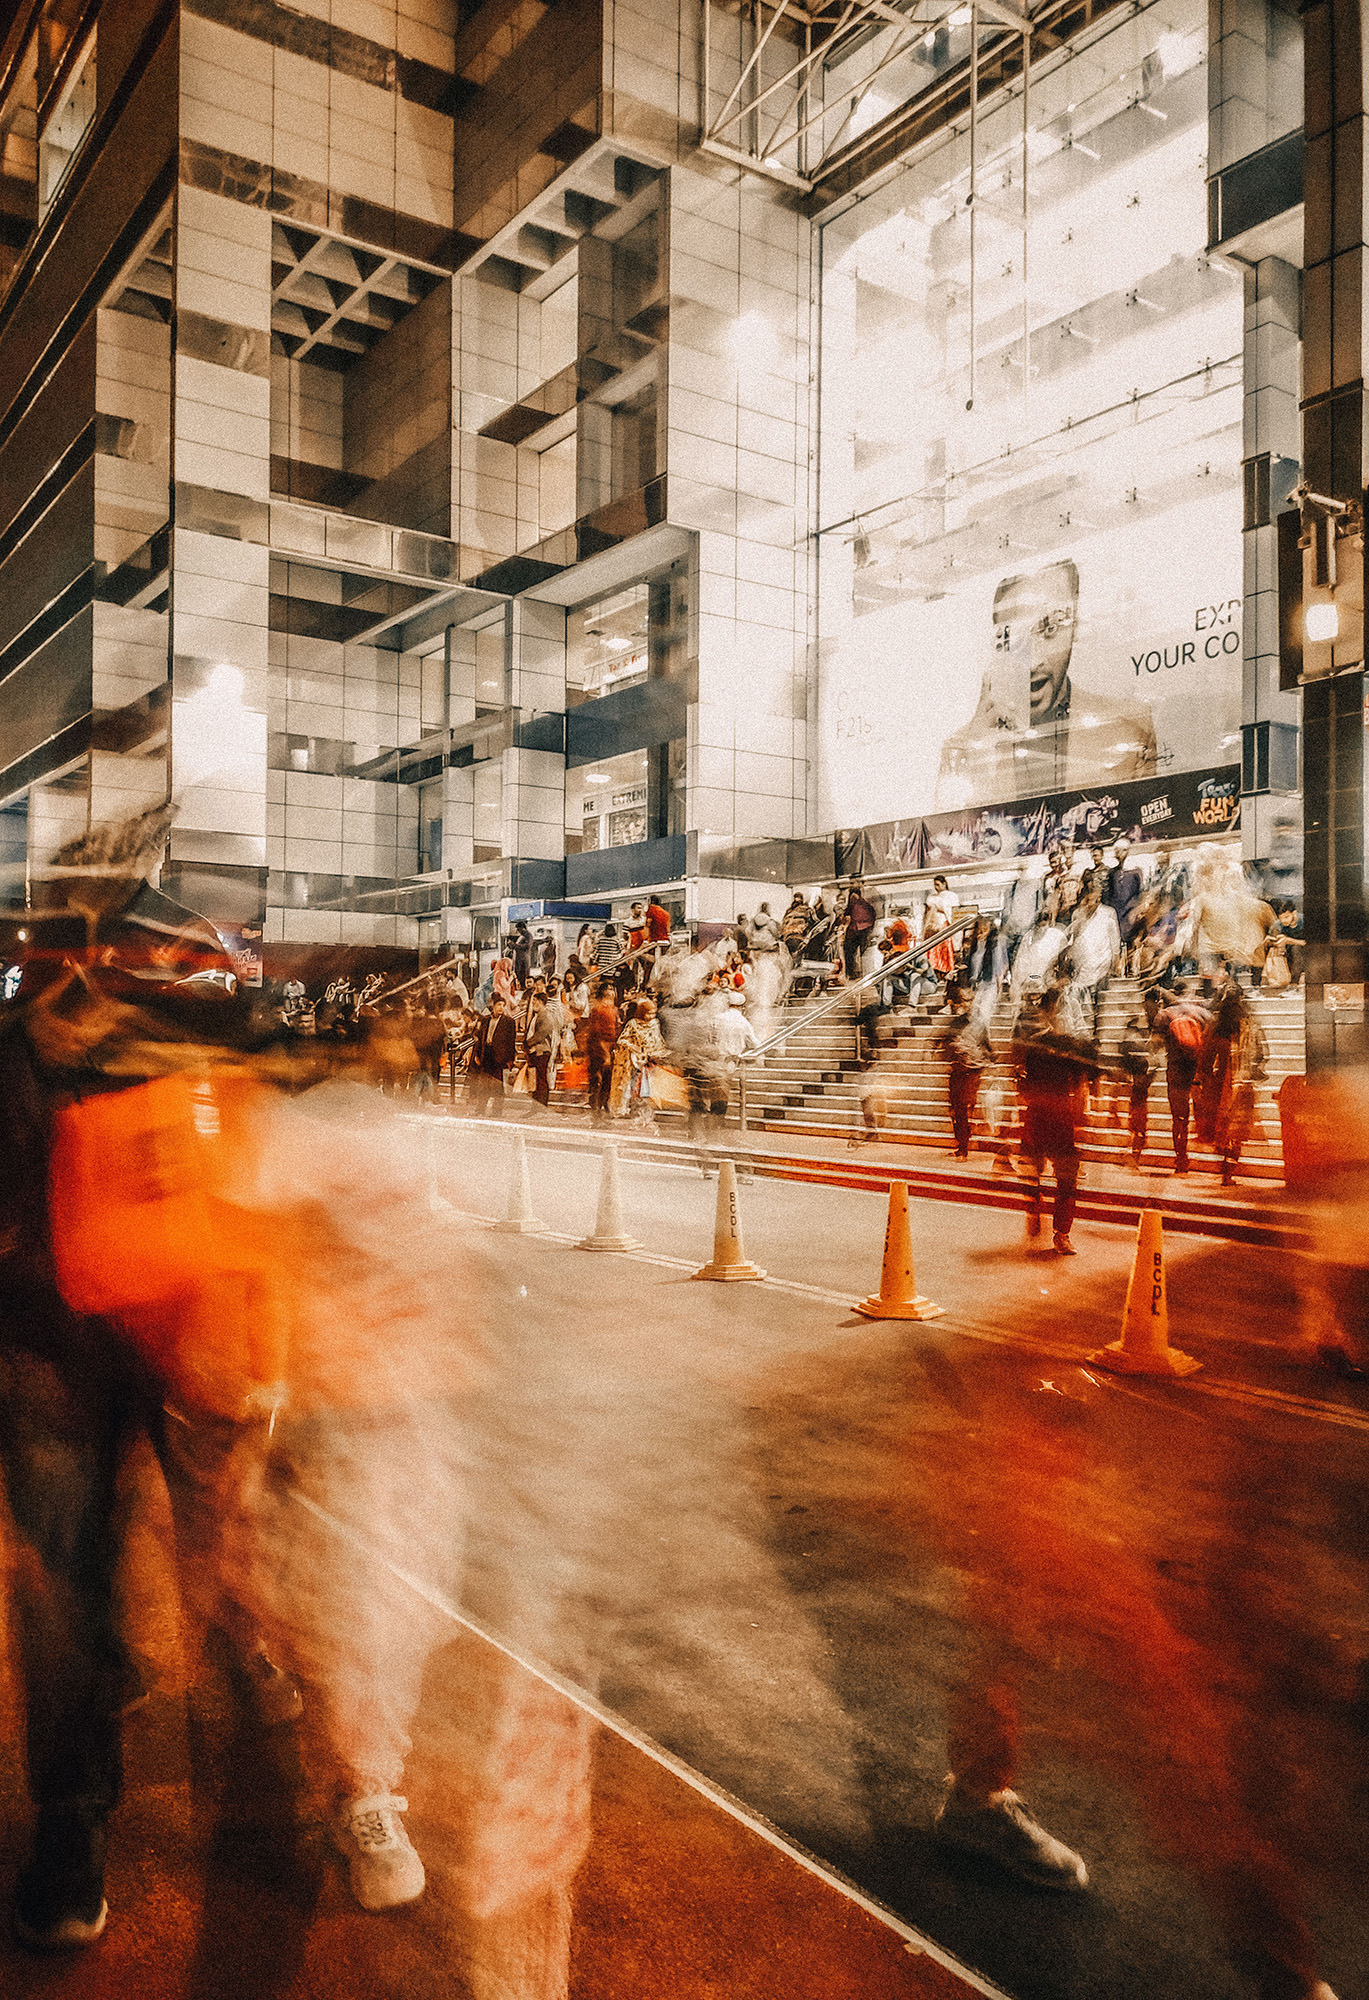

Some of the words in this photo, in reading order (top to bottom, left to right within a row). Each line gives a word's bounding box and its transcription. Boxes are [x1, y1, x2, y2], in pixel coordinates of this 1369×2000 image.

[1131, 641, 1196, 676] YOUR
[1204, 631, 1240, 659] CO
[1140, 798, 1169, 816] OPEN
[1200, 795, 1235, 812] FUN
[1141, 808, 1173, 825] EVERYDAY
